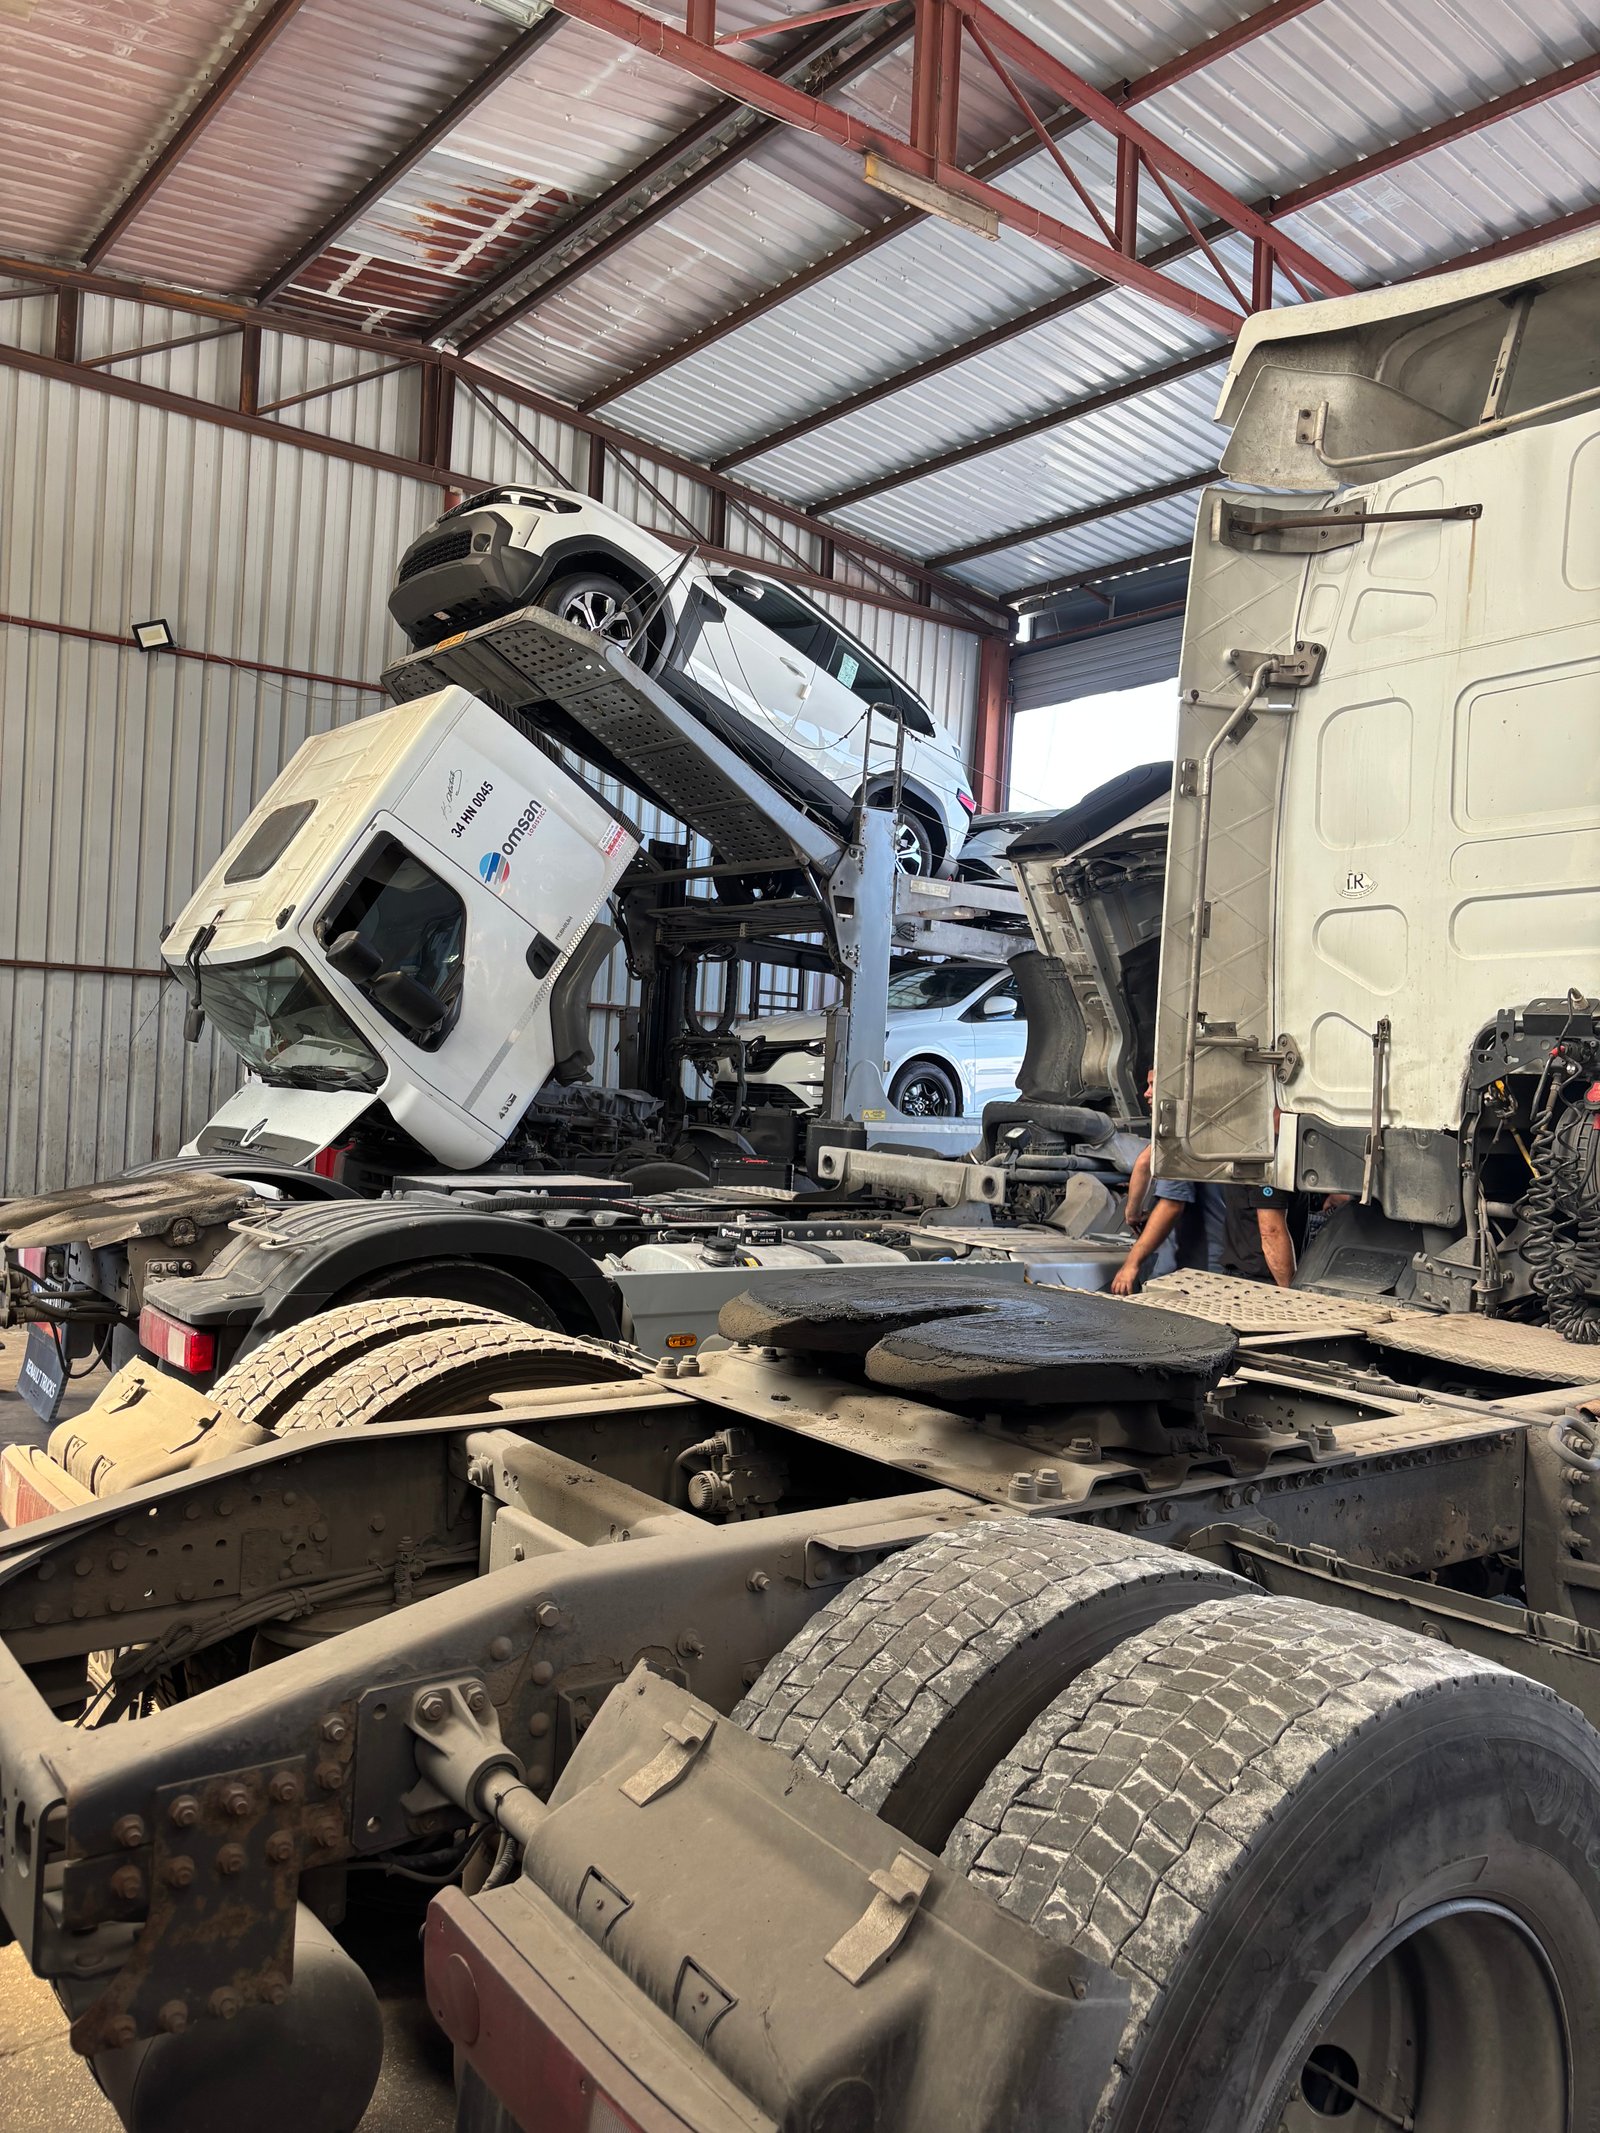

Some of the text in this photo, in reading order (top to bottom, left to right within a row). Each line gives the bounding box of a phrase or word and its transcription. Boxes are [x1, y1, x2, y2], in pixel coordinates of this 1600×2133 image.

[451, 780, 494, 838] 34 HN 0045
[501, 799, 542, 856] omsan
[527, 807, 547, 837] LOGISTICS
[25, 1358, 42, 1385] RENAULT
[40, 1370, 57, 1399] TRUCKS
